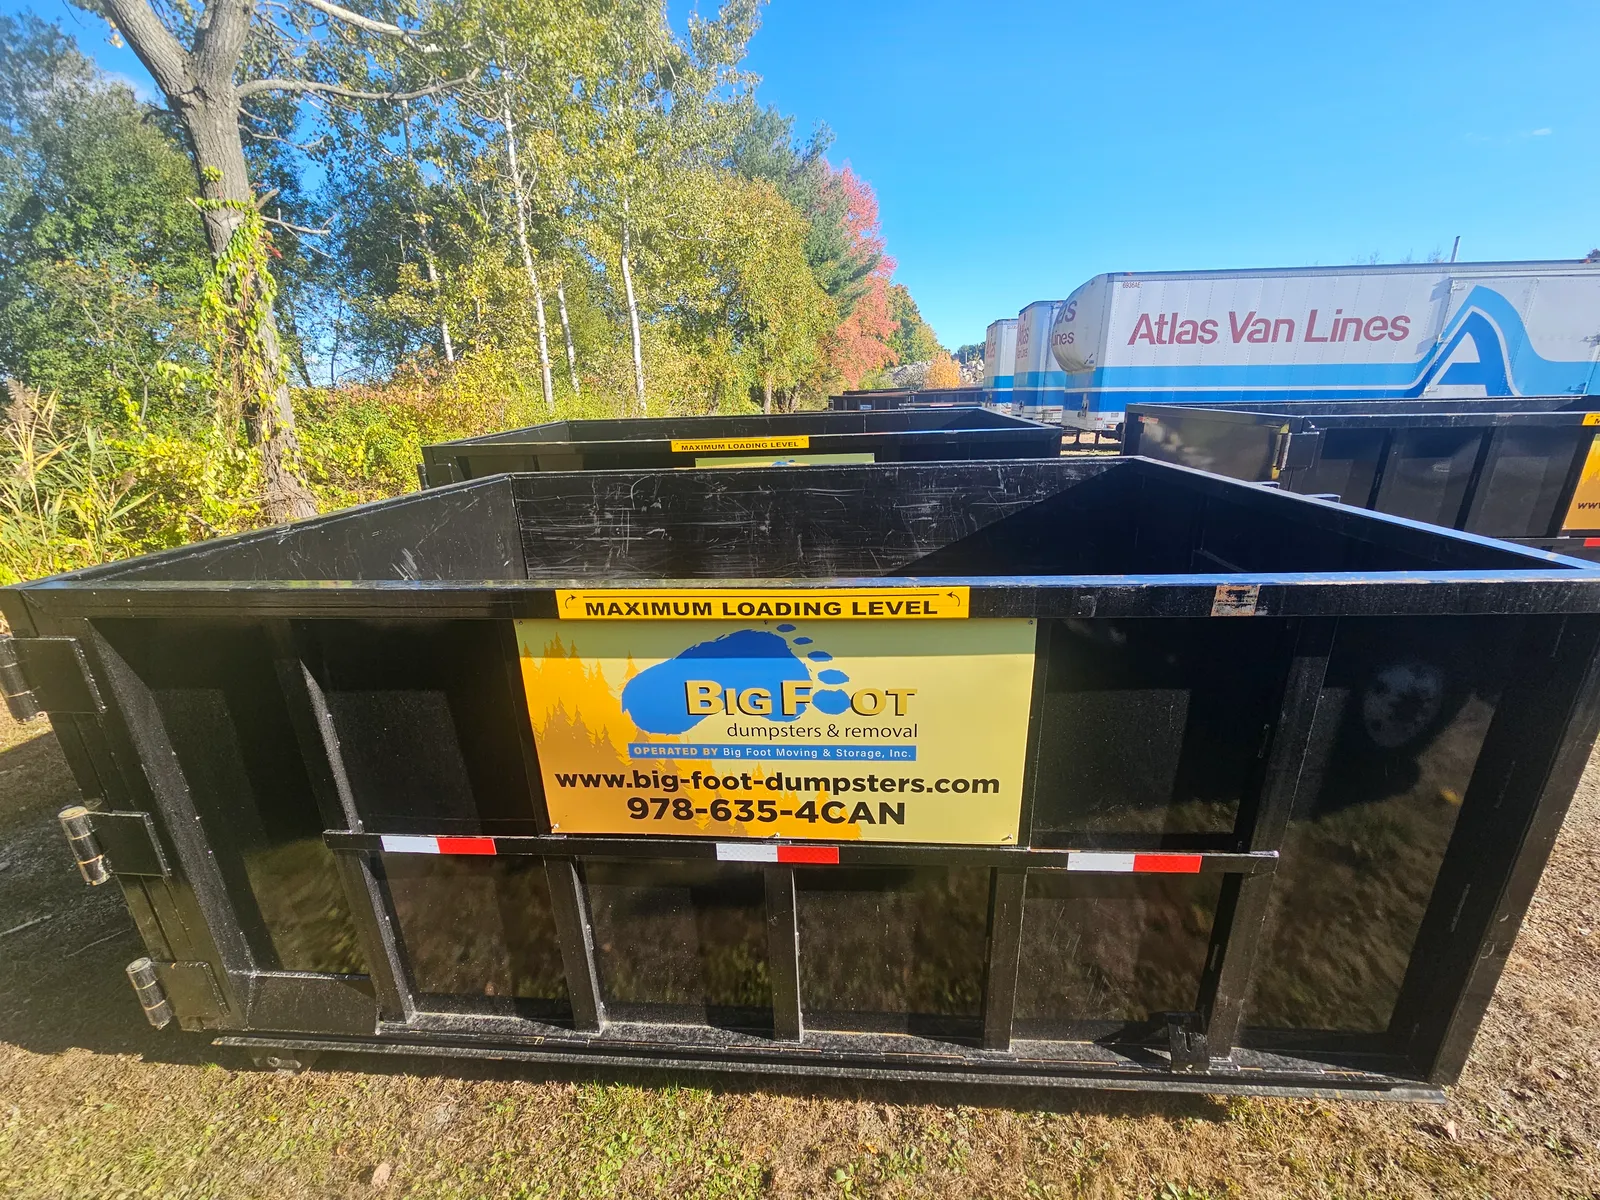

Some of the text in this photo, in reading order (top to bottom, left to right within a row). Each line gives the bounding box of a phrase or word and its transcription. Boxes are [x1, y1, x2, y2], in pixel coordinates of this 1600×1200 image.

[1127, 308, 1411, 346] Atlas Van Lines
[681, 443, 724, 451] MAXIMUM
[728, 442, 768, 450] LOADING
[585, 600, 938, 616] MAXIMUM LOADING LEVEL
[684, 680, 773, 716] BIG
[726, 723, 918, 741] dumpsters & removal
[633, 746, 912, 759] OPERATED BY Big Foot Moving & Storage, Inc.
[554, 770, 1000, 796] www.big-foot-dumpsters.com
[627, 797, 906, 825] 978-635-4CAN
